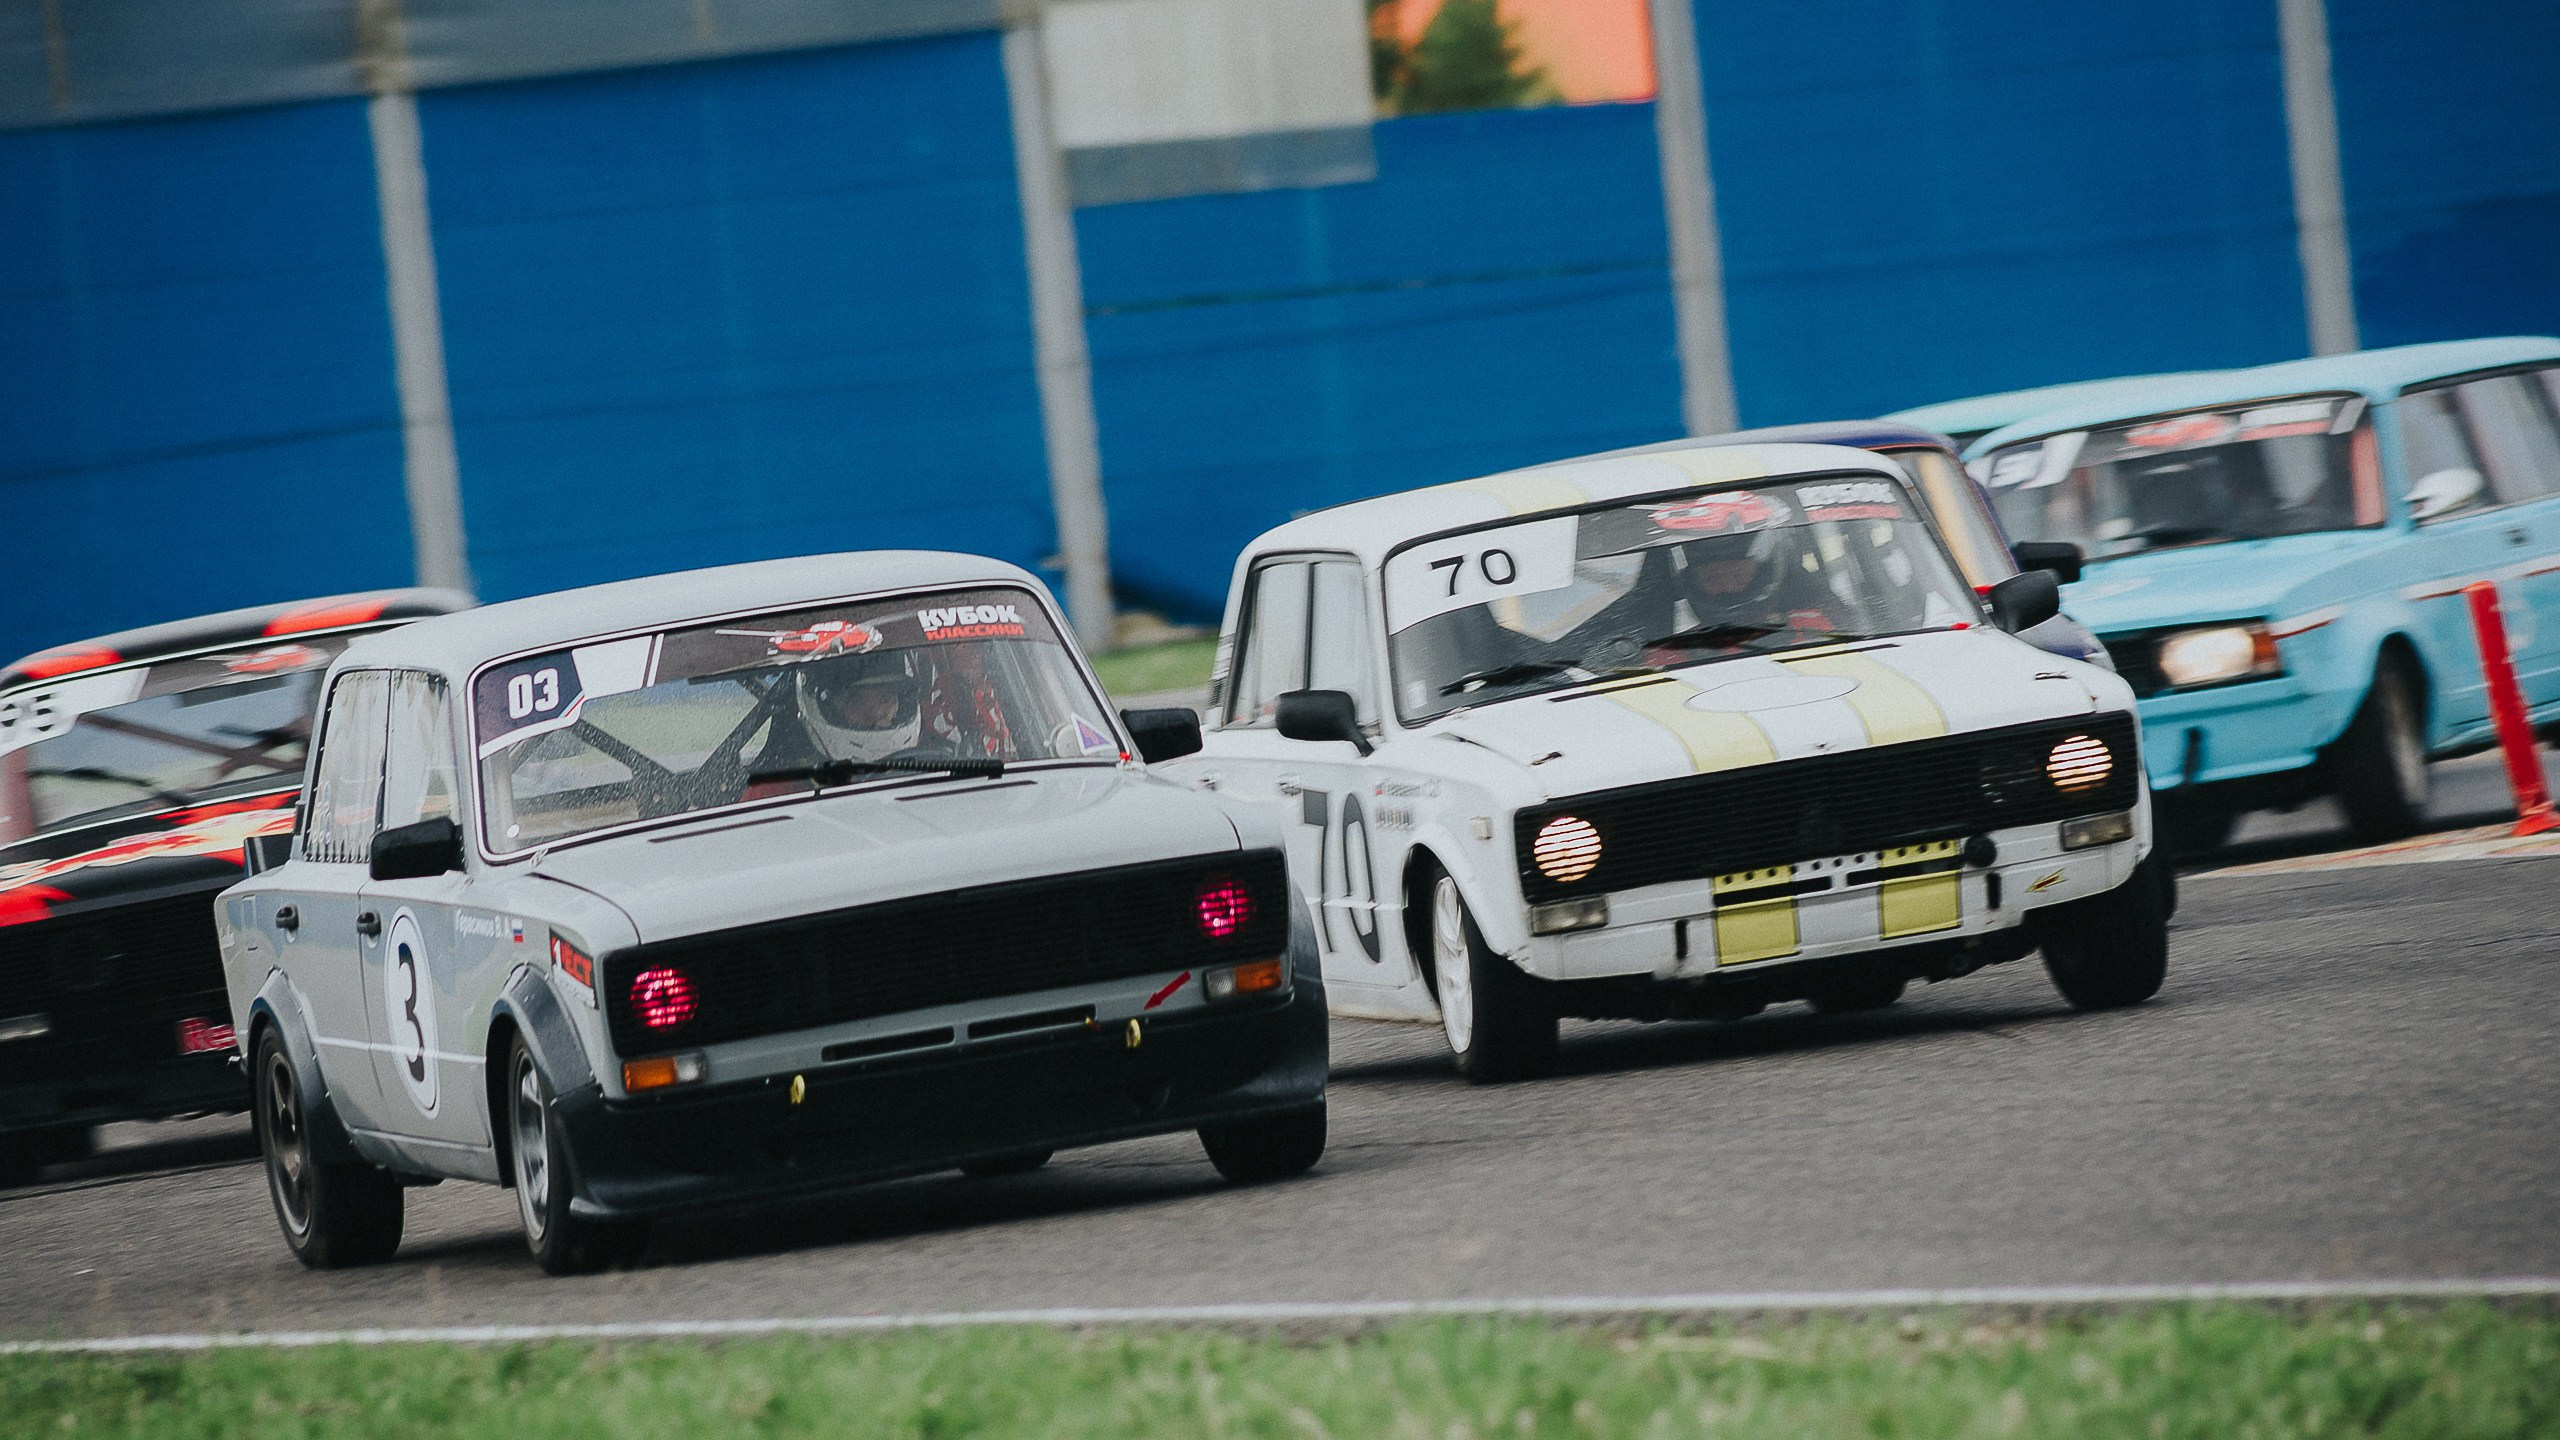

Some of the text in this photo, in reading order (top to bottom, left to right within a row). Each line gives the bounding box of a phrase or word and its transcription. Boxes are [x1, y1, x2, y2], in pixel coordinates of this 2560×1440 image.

[1430, 549, 1516, 597] 70
[917, 604, 1022, 629] КУБОК
[925, 614, 1024, 640] КЛАССИКИ
[508, 667, 560, 719] 03
[1303, 789, 1381, 963] 70
[397, 942, 425, 1083] 3
